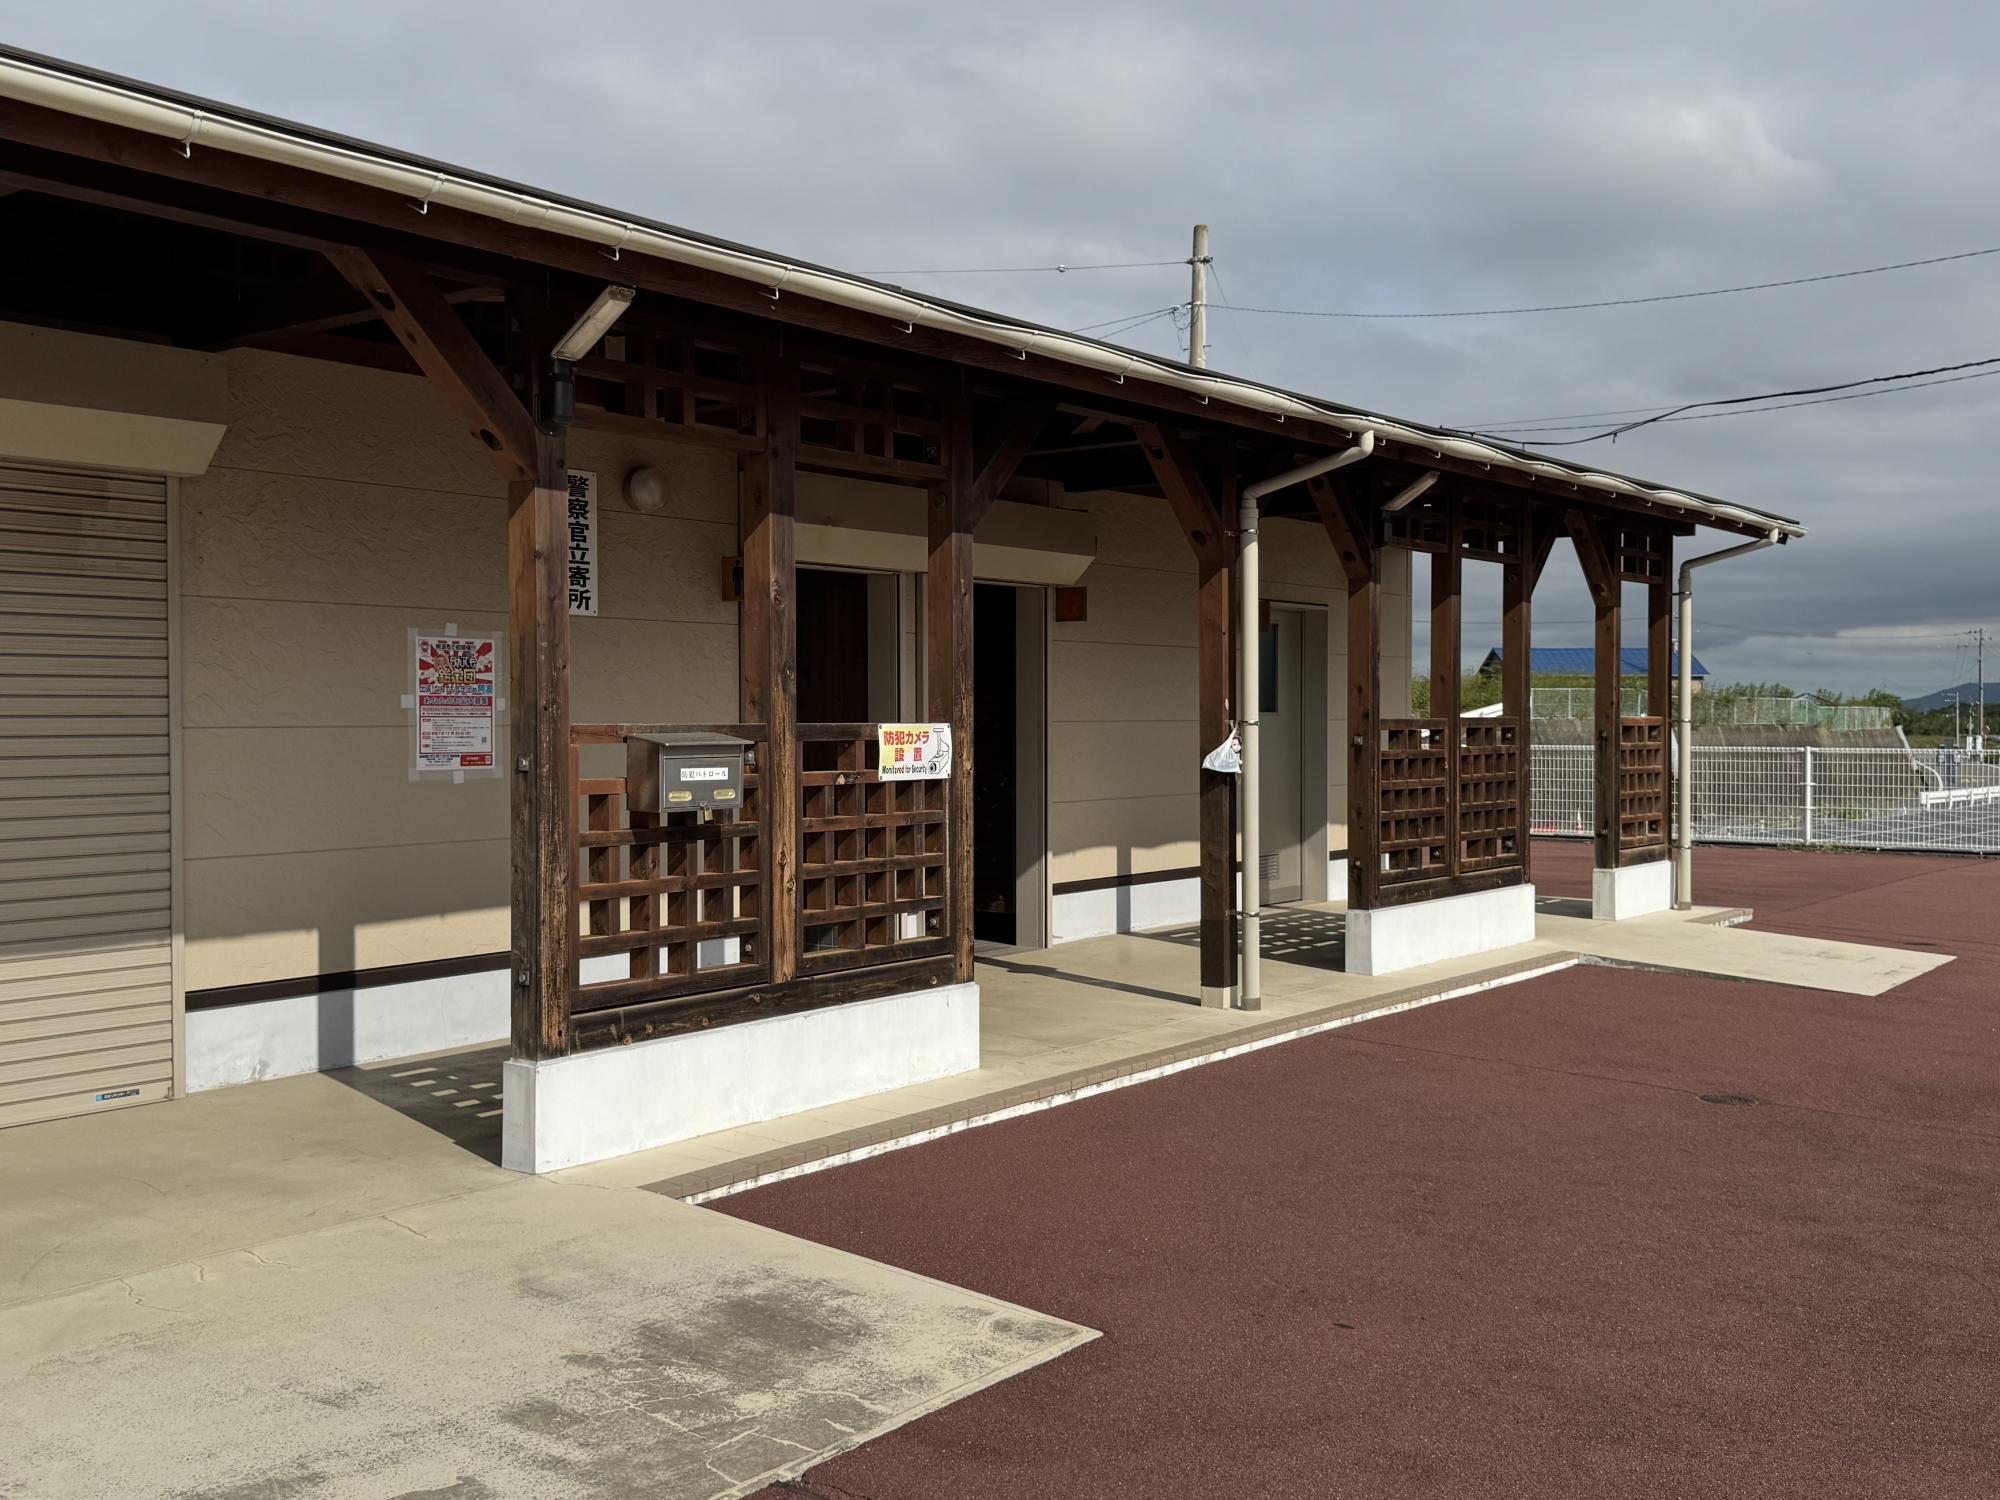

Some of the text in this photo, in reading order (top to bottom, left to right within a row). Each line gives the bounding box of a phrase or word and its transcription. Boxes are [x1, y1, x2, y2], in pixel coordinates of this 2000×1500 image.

[567, 474, 591, 611] 警察官立寄所
[883, 730, 930, 746] 防犯カメラ
[882, 765, 904, 775] Monitored
[911, 764, 927, 775] Security
